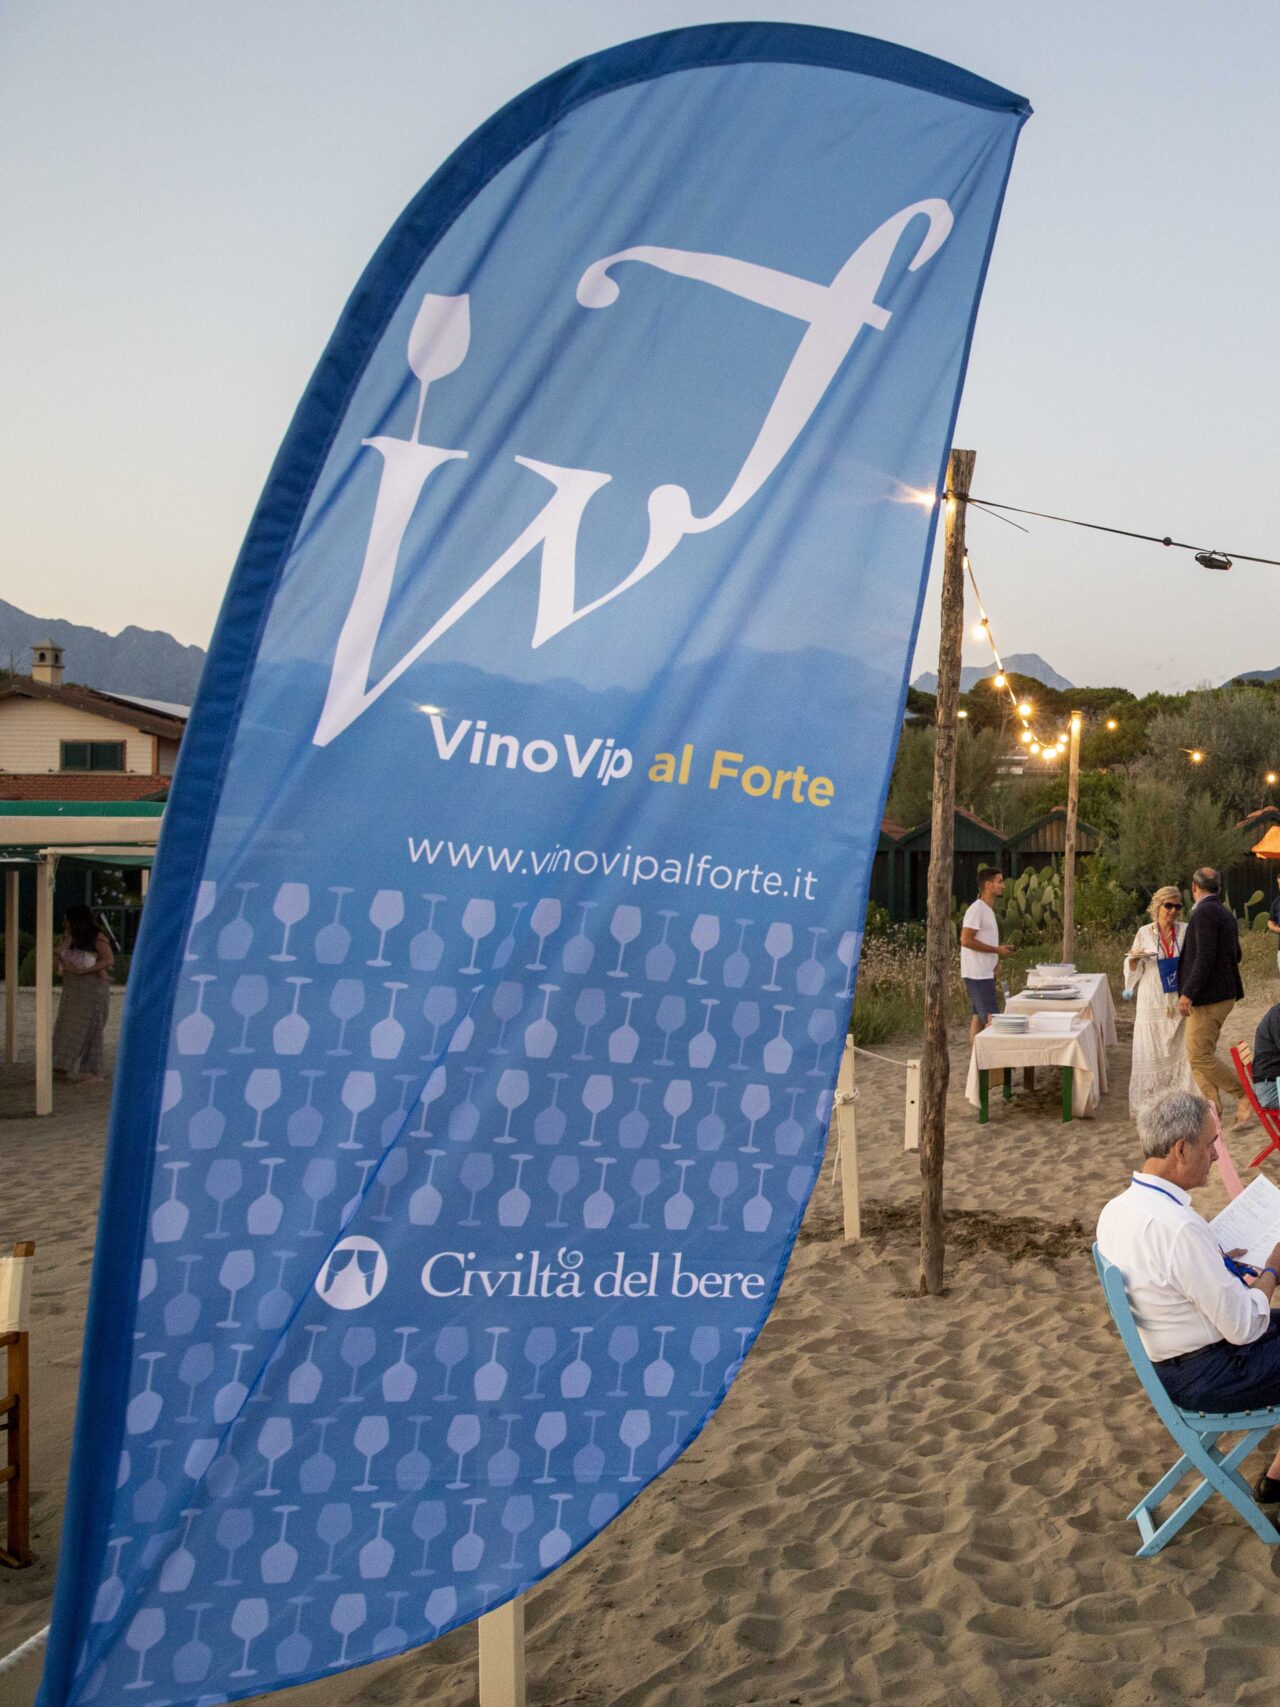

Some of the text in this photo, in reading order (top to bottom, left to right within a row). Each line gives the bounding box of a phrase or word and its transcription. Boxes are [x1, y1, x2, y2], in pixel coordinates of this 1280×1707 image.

[427, 714, 835, 807] VinoVip al Forte
[407, 836, 819, 901] www.vinovipalforte.it
[594, 1251, 659, 1298] del
[671, 1252, 766, 1299] bere
